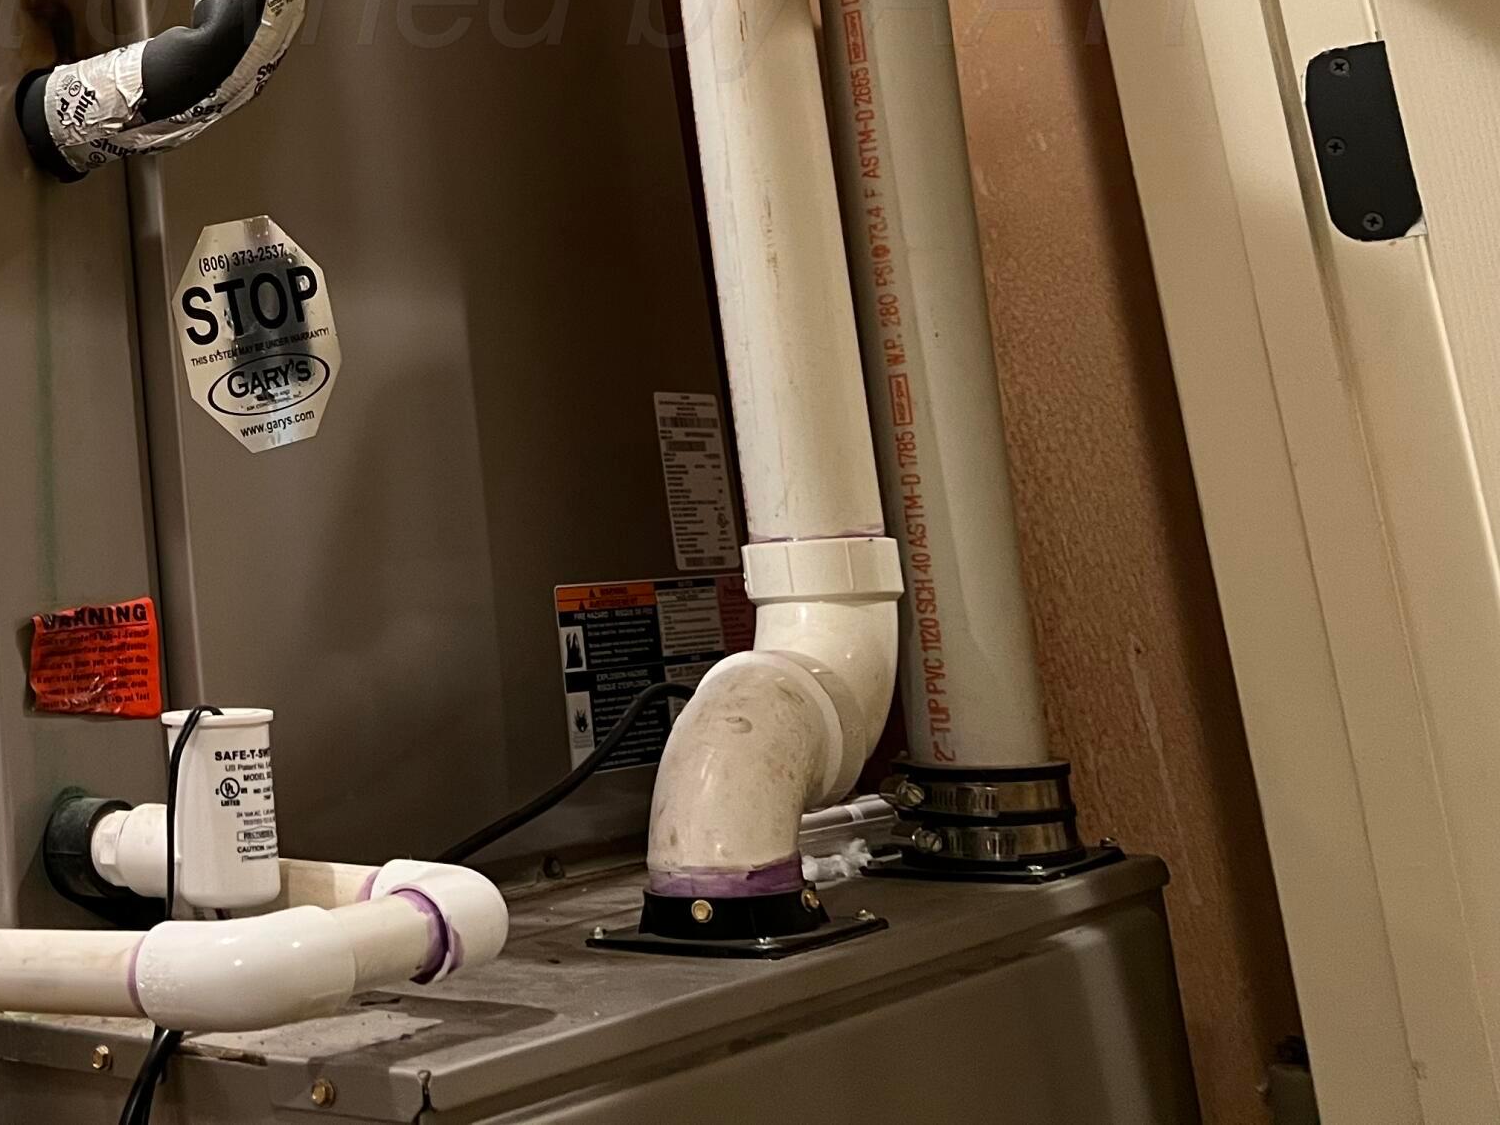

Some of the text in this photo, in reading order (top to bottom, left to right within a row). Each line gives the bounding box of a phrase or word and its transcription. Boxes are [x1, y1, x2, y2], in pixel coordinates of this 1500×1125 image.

[850, 67, 873, 108] 2665
[855, 109, 882, 181] ASTM-D
[864, 188, 881, 200] F
[198, 243, 285, 276] (806) 373-2537
[182, 265, 318, 345] STOP
[877, 293, 901, 328] 280
[191, 328, 330, 367] THIS SYSTEM MAY BE UNDER WARRANTY!
[227, 358, 311, 398] GARY'S
[240, 409, 315, 437] www.garys.com
[895, 430, 918, 469] 1785
[900, 473, 928, 549] ASTM-D
[911, 552, 933, 575] 40
[915, 578, 937, 616] SCH
[920, 617, 943, 653] 1120
[923, 657, 947, 696] PVC
[928, 698, 951, 736] TUP
[237, 845, 265, 853] CAUTION
